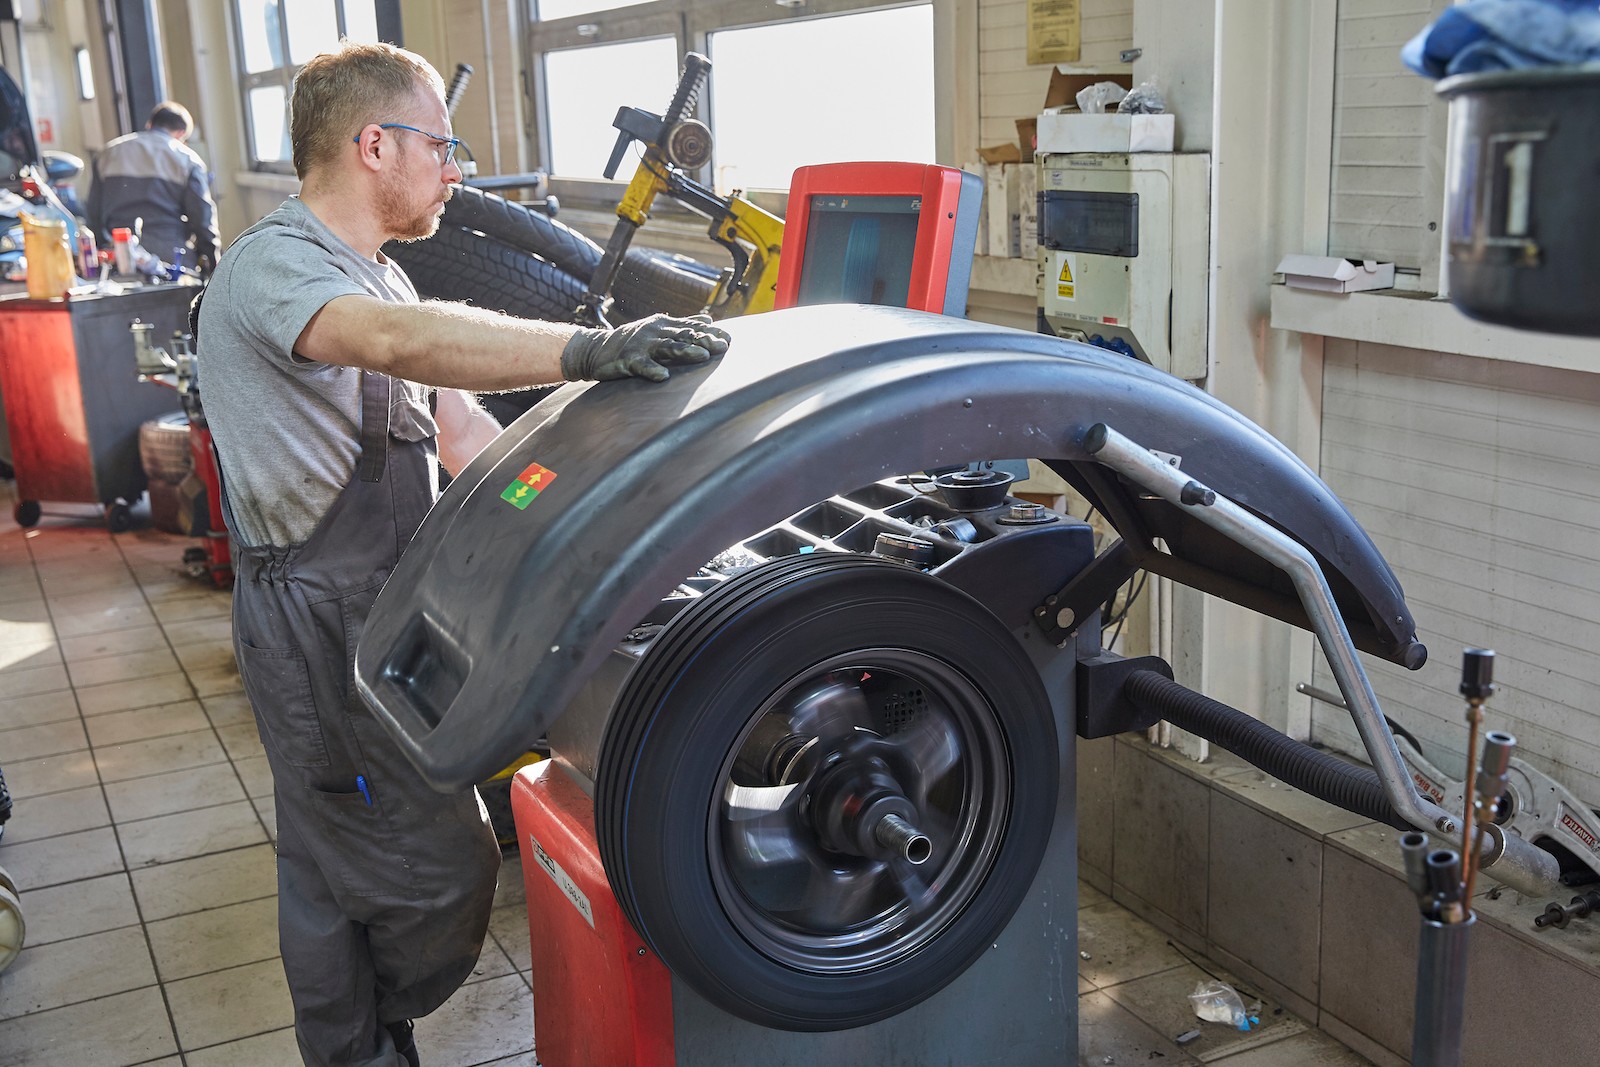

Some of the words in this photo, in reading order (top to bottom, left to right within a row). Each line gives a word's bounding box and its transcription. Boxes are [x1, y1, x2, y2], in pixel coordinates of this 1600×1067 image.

[1414, 774, 1431, 792] Bike
[1430, 788, 1444, 803] Pro
[1563, 814, 1594, 845] HAWEKA
